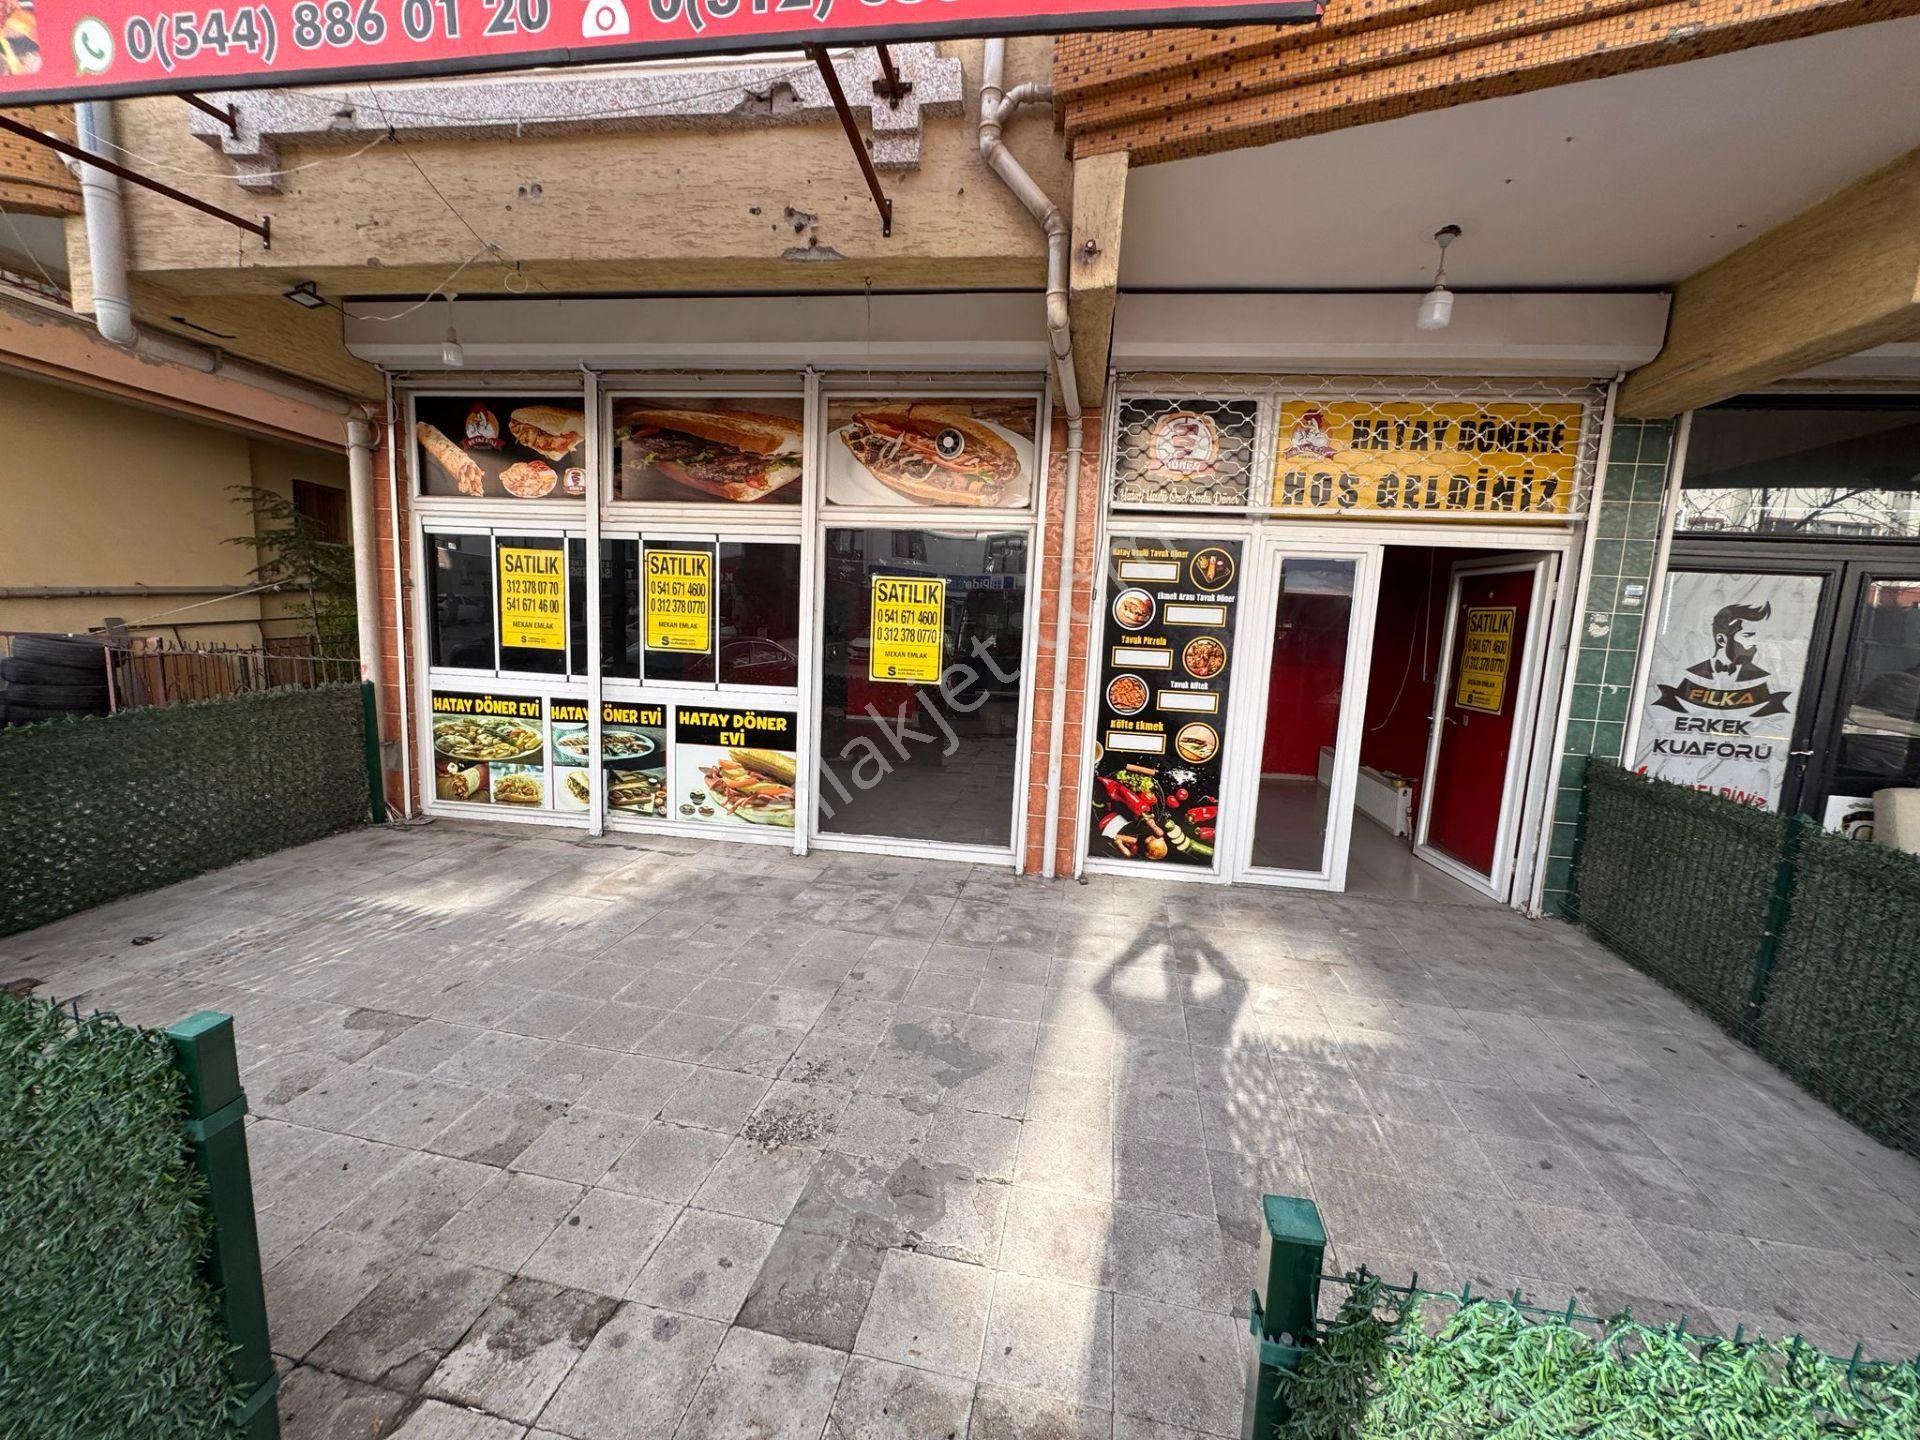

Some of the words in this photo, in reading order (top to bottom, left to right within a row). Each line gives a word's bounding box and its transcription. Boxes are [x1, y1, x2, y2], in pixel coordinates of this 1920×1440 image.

[124, 4, 278, 73] 0(544)
[293, 0, 387, 50] 886
[401, 0, 460, 42] 01
[483, 0, 551, 37] 20
[1351, 420, 1450, 450] HATAY
[1376, 468, 1558, 511] GELDİNİZ
[505, 554, 559, 574] SATILIK
[650, 556, 706, 576] SATILIK
[507, 579, 521, 593] 312
[522, 580, 536, 594] 378
[651, 581, 655, 594] 0
[657, 581, 670, 595] 541
[672, 582, 685, 596] 671
[688, 583, 705, 597] 4600
[878, 583, 938, 604] SATILIK
[507, 597, 520, 611] 541
[522, 598, 536, 612] 671
[651, 598, 655, 612] 0
[657, 598, 670, 612] 312
[672, 599, 685, 613] 378
[687, 600, 705, 614] 0770
[877, 609, 882, 622] 0
[885, 609, 898, 623] 541
[901, 610, 915, 624] 671
[918, 611, 938, 625] 4600
[1470, 614, 1512, 633] SATILIK
[877, 626, 882, 640] 0
[884, 627, 899, 641] 312
[901, 628, 915, 642] 378
[917, 629, 936, 643] 0770
[433, 697, 472, 712] HATAY
[475, 696, 517, 714] DÖNER
[519, 699, 540, 717] EVİ
[551, 705, 589, 721] HATAY
[603, 704, 638, 724] ÖNER
[640, 707, 662, 725] EVİ
[679, 712, 728, 727] HATAY
[733, 710, 787, 731] DÖNER
[1110, 719, 1134, 729] Köfte
[1136, 720, 1163, 731] Ekmek
[1674, 716, 1752, 735] ERKEK
[720, 729, 745, 746] EVİ
[1652, 739, 1772, 760] KUAFÖRÜ
